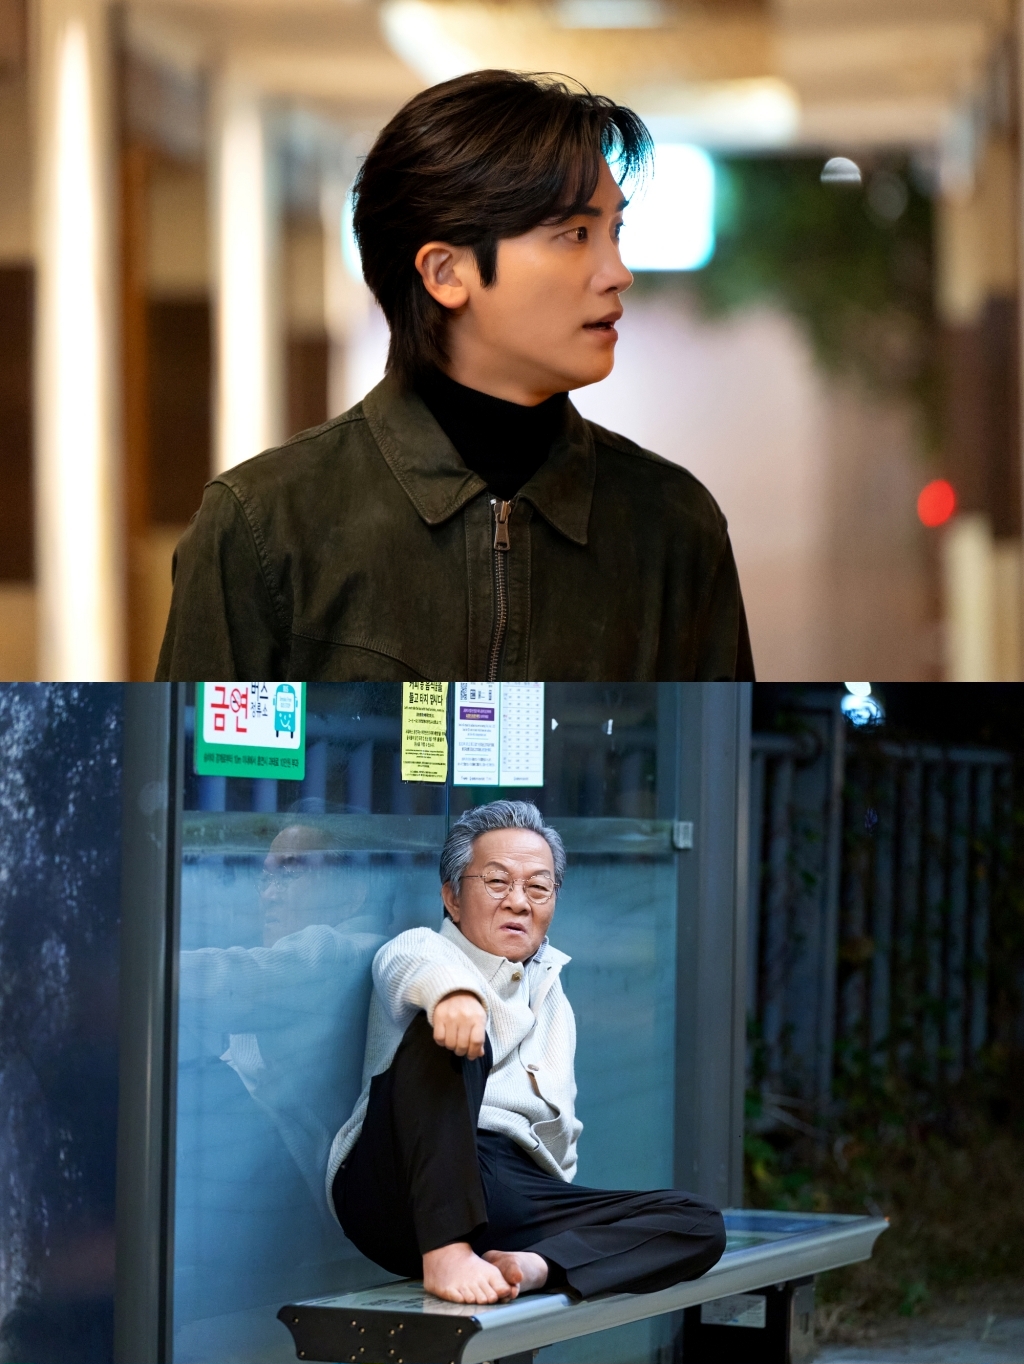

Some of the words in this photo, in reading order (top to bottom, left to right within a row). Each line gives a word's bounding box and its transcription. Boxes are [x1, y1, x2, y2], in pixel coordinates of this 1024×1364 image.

[251, 682, 269, 701] 버스
[409, 692, 419, 704] 들고
[420, 693, 429, 705] 타지
[430, 694, 443, 706] 맙시다
[211, 686, 248, 733] 금연
[251, 702, 269, 718] 정류소
